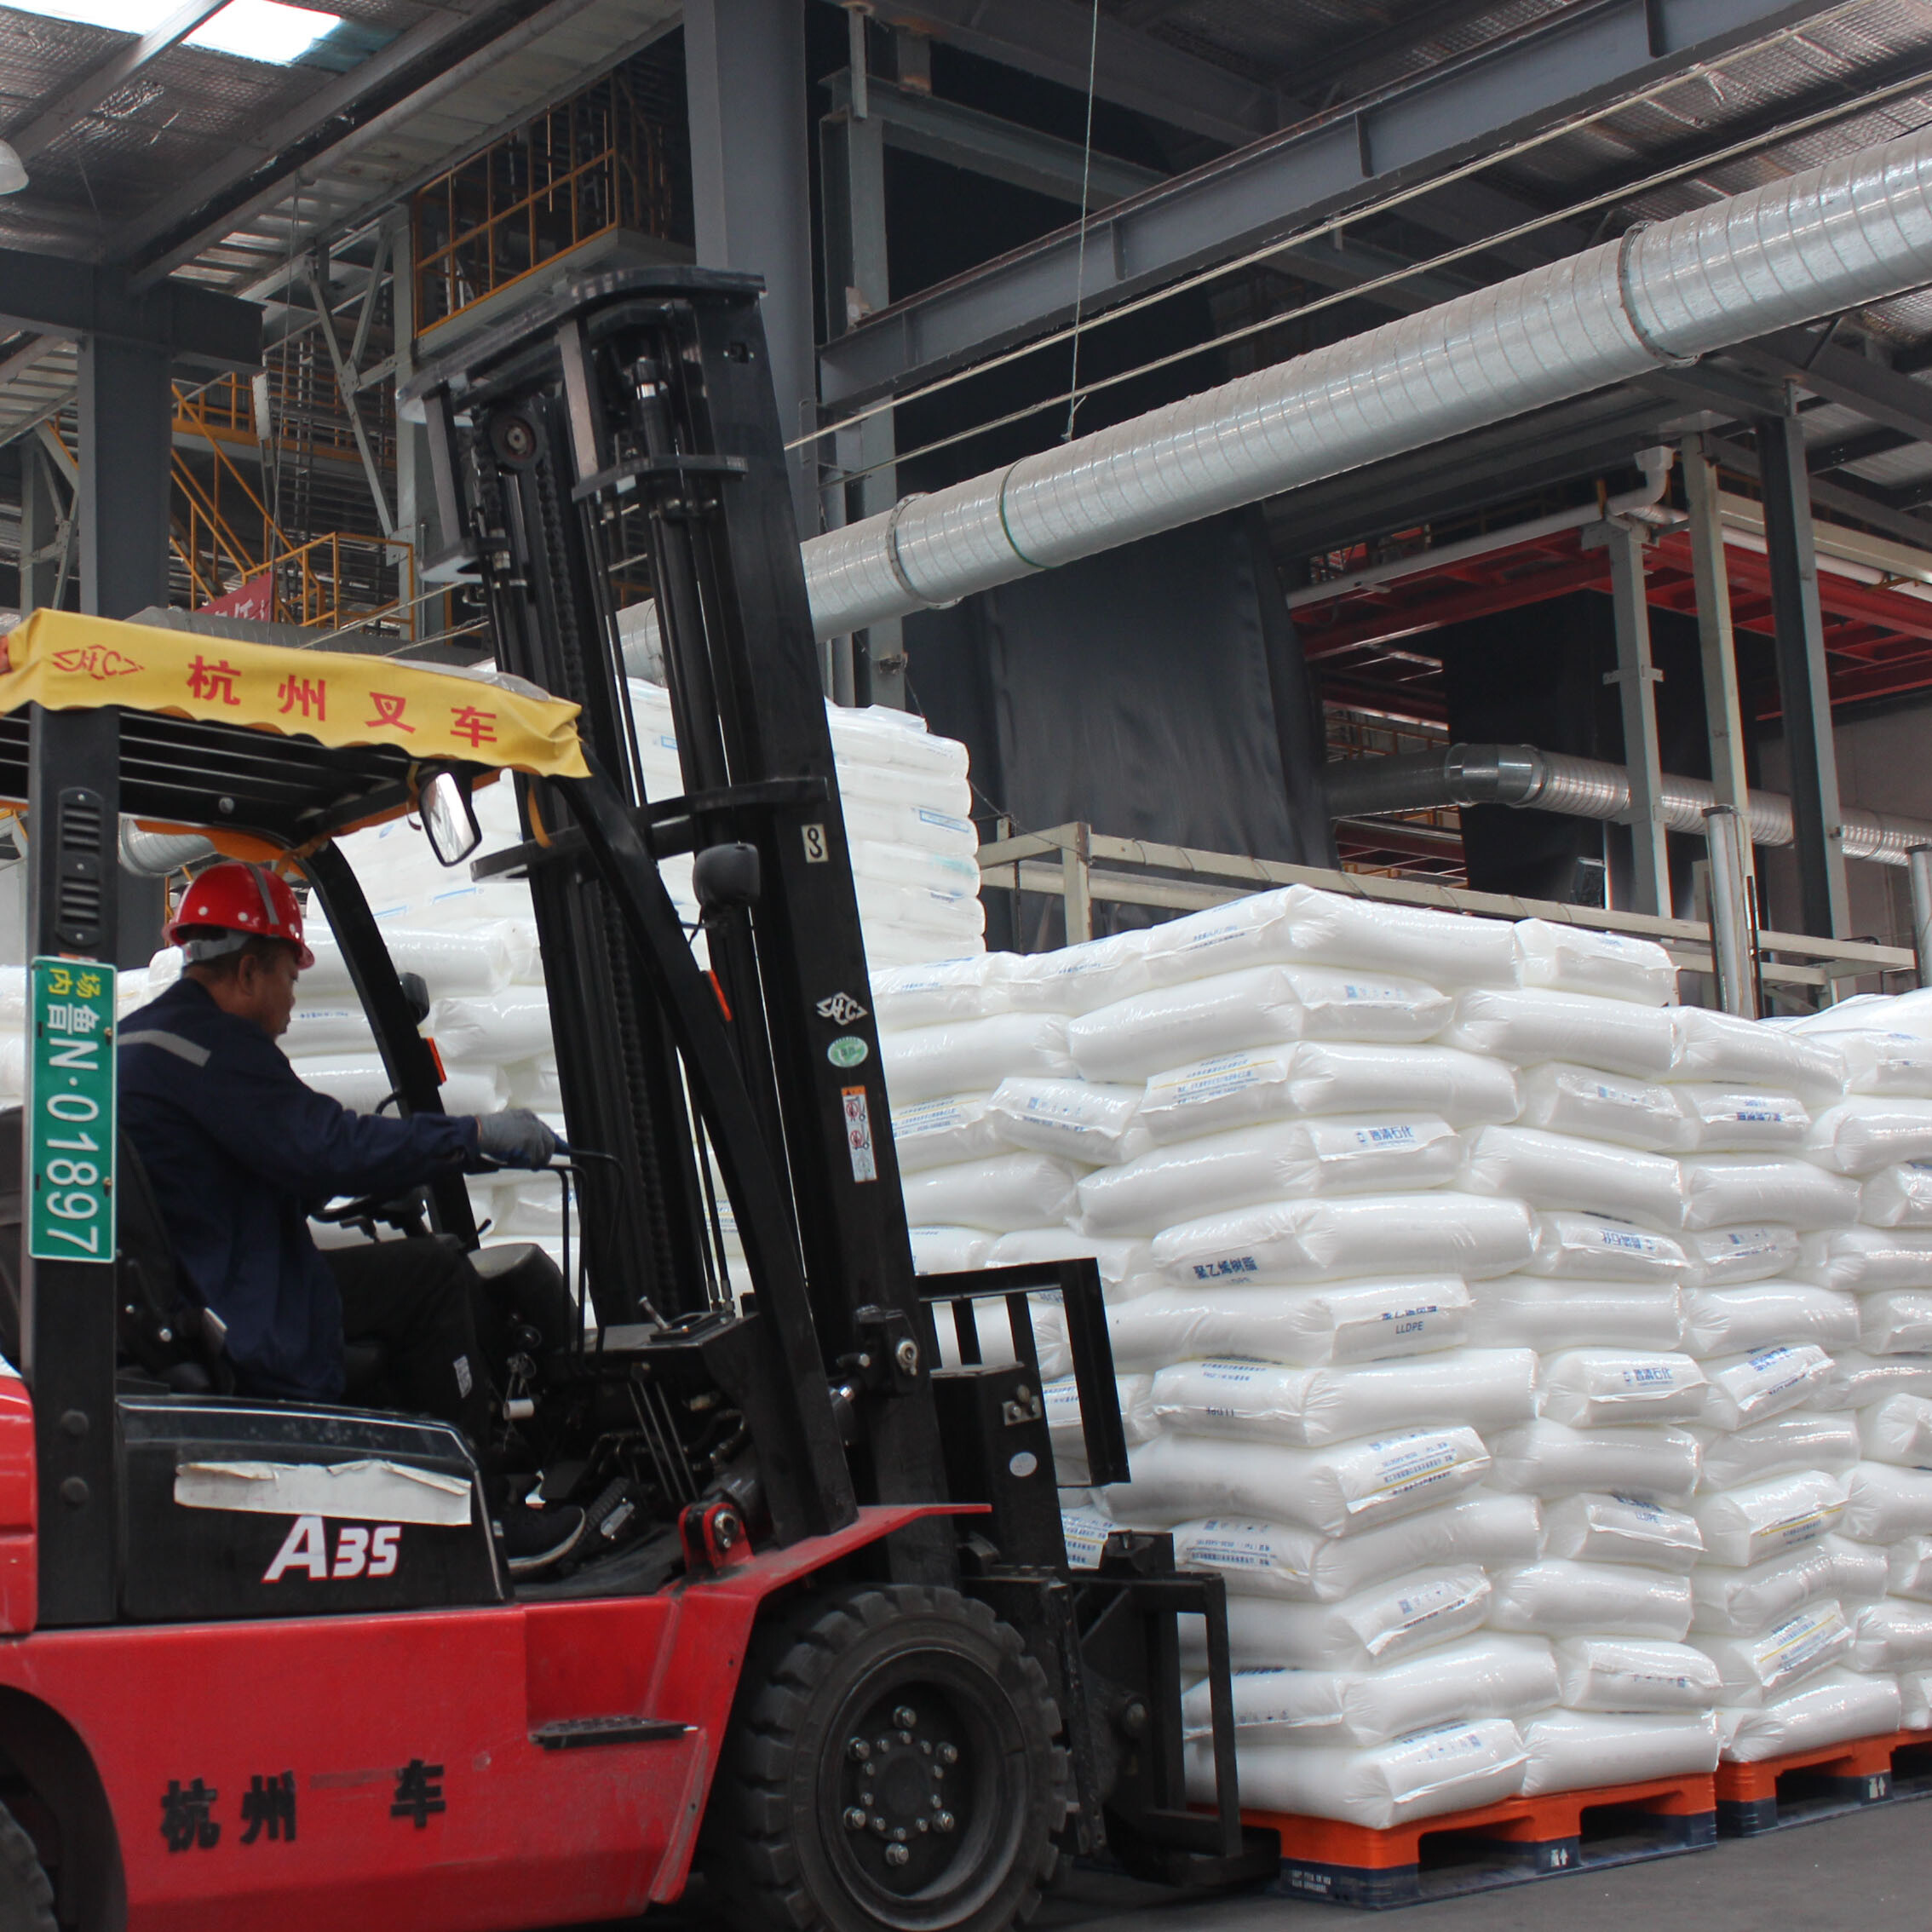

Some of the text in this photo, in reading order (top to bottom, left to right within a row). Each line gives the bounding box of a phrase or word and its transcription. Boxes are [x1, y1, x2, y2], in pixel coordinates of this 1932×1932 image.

[187, 654, 497, 748] 杭州叉车
[48, 968, 101, 999] 场内
[1395, 1320, 1424, 1335] LLDPE
[261, 1515, 401, 1584] A35
